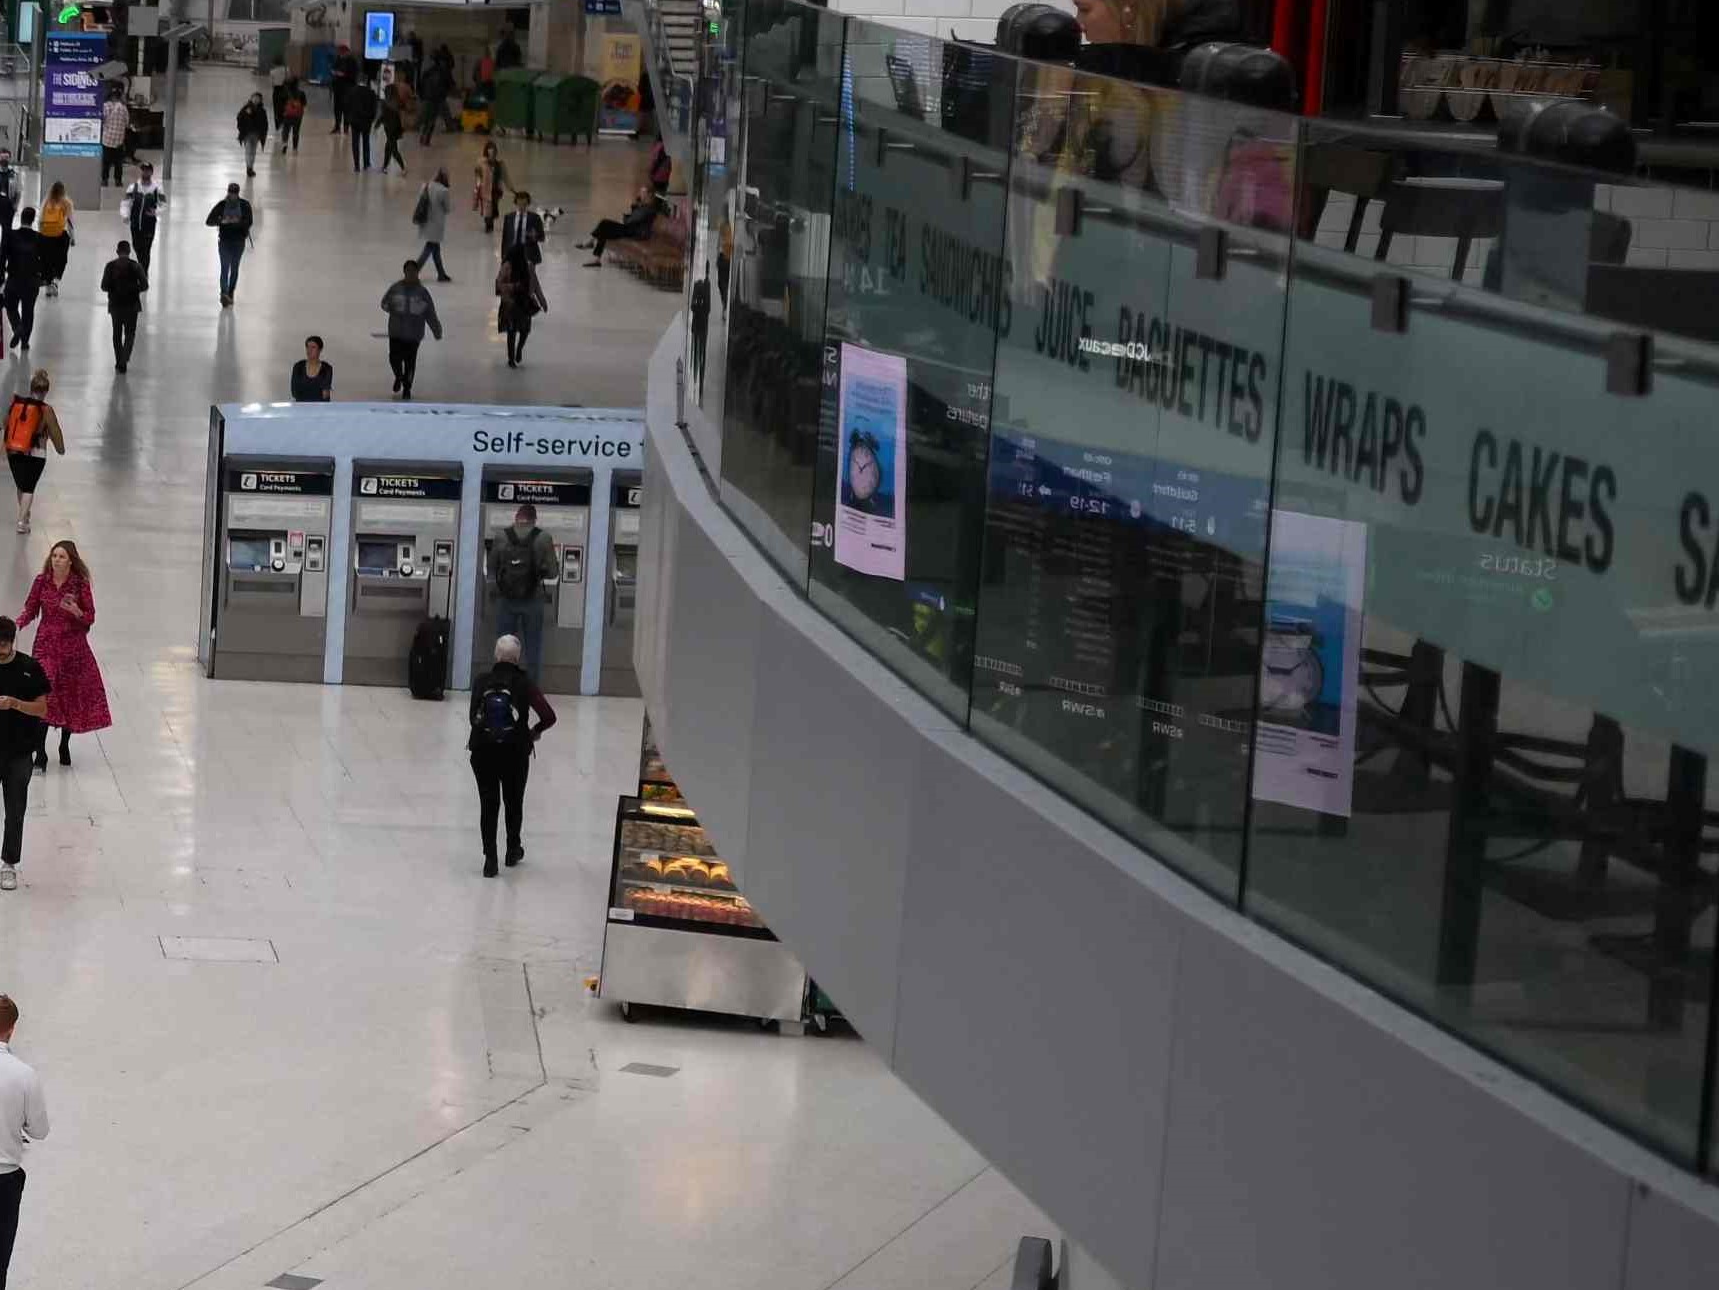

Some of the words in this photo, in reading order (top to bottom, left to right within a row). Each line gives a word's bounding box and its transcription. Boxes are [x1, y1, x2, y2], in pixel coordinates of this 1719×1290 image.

[1033, 278, 1094, 392] JUICE
[1115, 303, 1267, 445] BAGUETTES
[1303, 369, 1427, 507] WRAPS
[1467, 429, 1618, 576] CAKES
[472, 429, 632, 458] Self-service
[260, 474, 296, 485] TICKETS
[380, 478, 419, 488] TICKETS
[277, 484, 302, 493] Payments
[378, 487, 395, 495] Card
[395, 487, 426, 497] Payments
[518, 484, 553, 495] TICKETS
